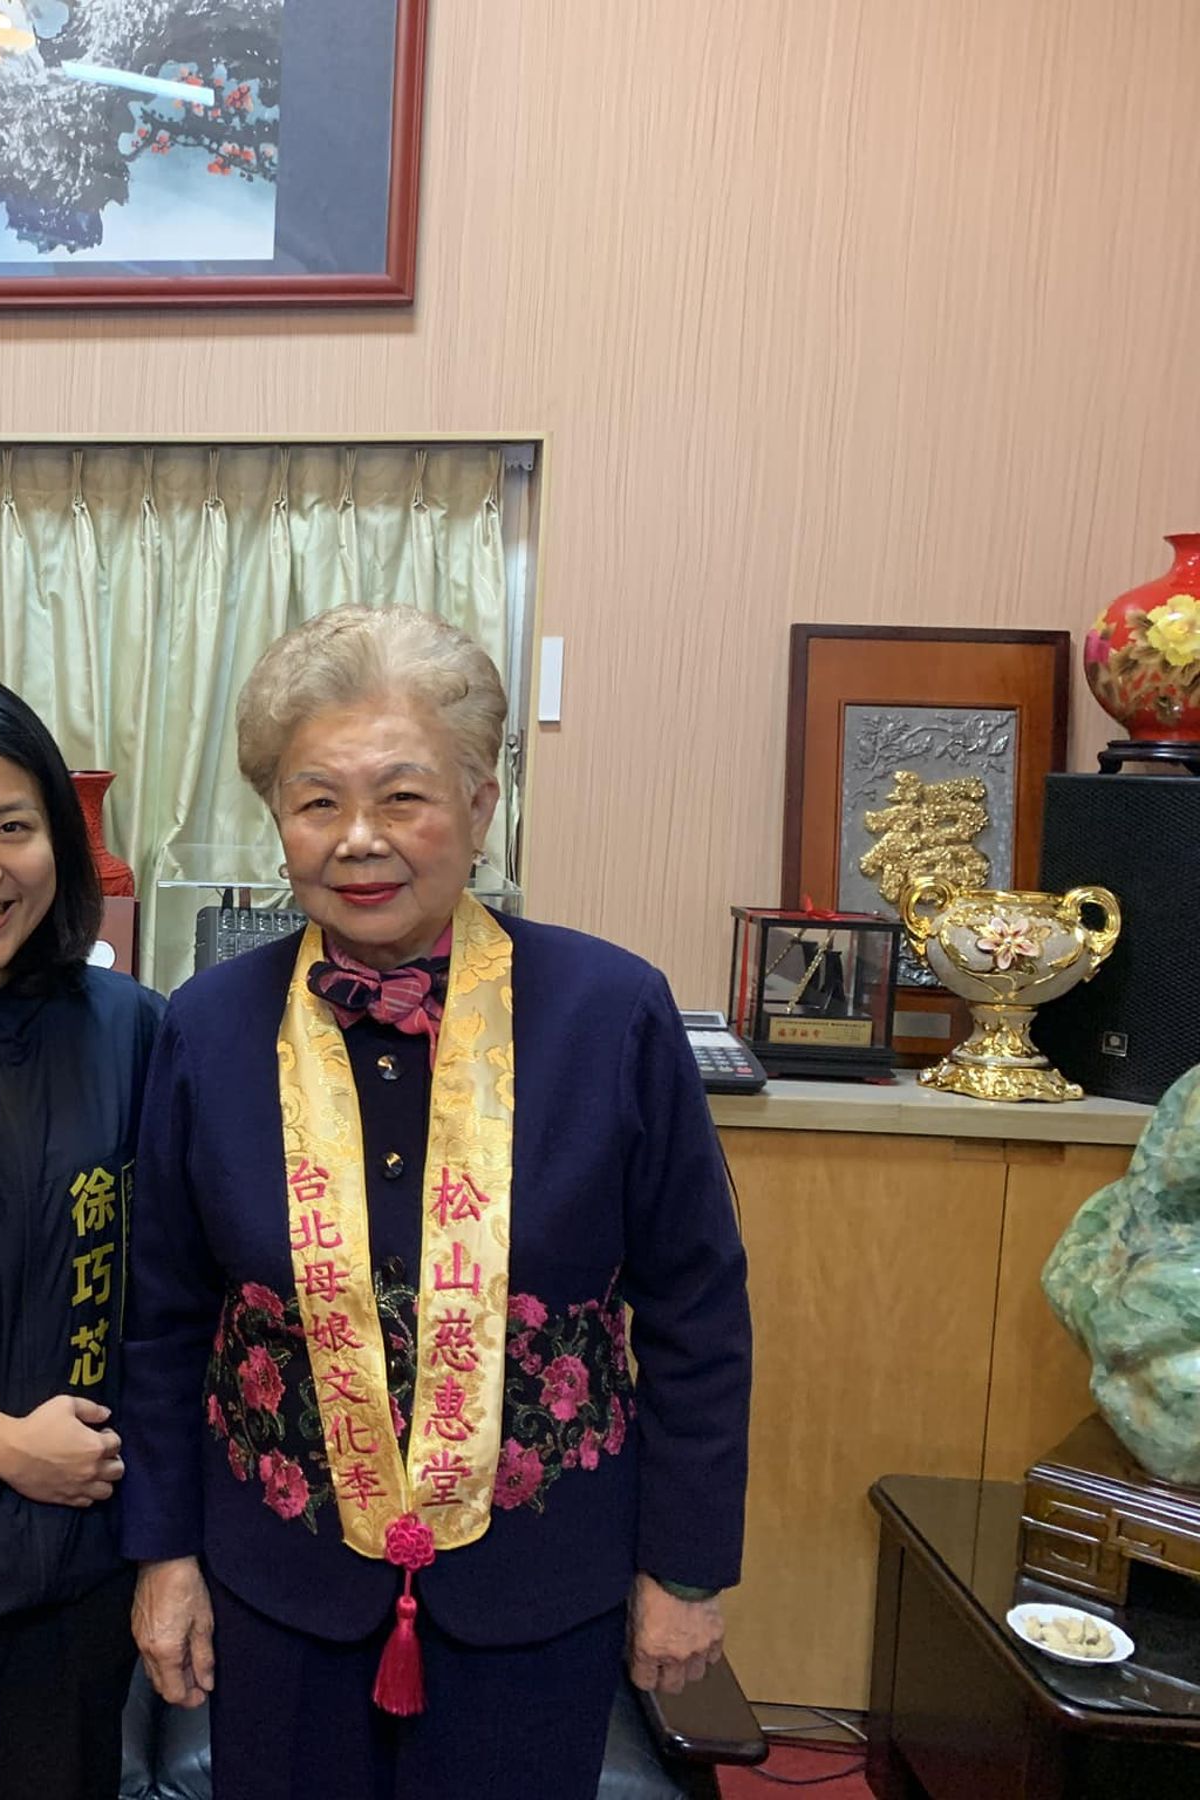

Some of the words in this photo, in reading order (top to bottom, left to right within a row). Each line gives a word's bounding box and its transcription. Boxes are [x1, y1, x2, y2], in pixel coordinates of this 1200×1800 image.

[69, 1167, 115, 1385] 徐巧芯
[287, 1159, 386, 1510] 台北母娘文化季
[420, 1167, 490, 1508] 松山慈惠堂
